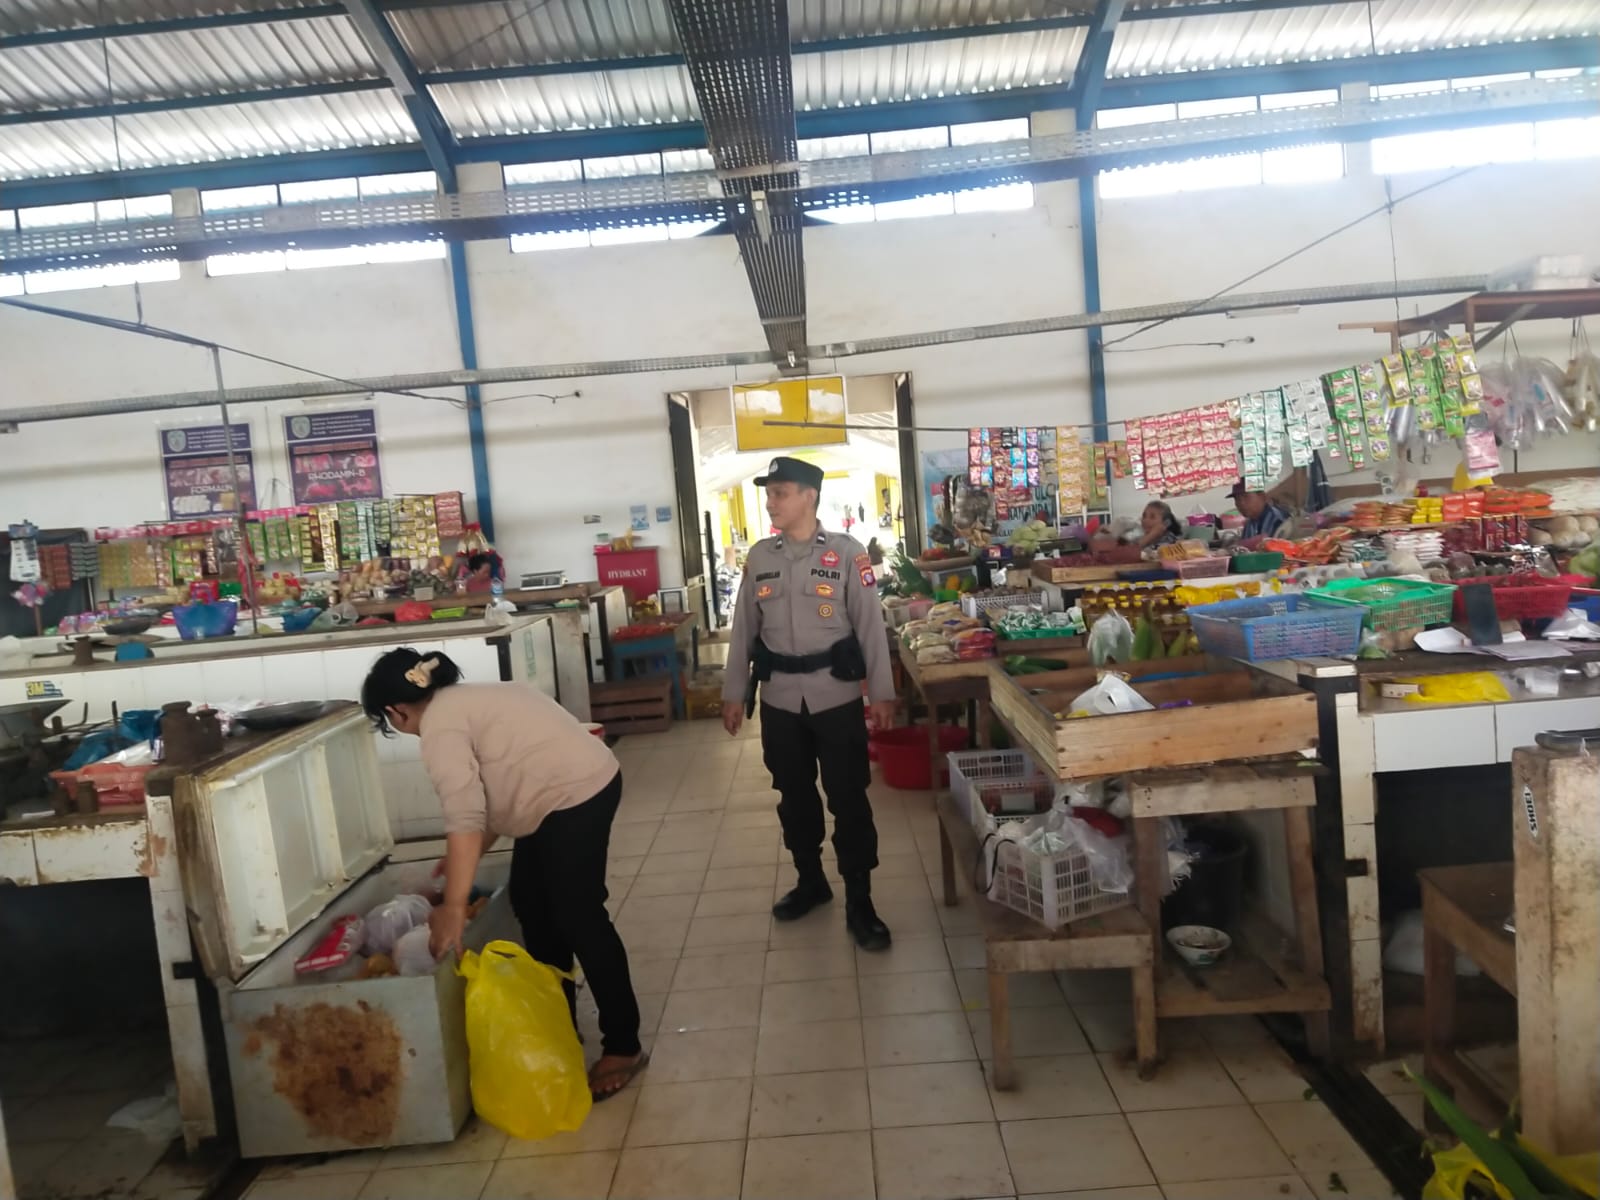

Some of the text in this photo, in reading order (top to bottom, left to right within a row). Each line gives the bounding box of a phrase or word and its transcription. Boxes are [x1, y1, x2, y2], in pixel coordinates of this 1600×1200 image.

[607, 568, 648, 580] HYDRANT
[810, 569, 841, 581] POLRI
[1524, 792, 1538, 832] SHOEI
